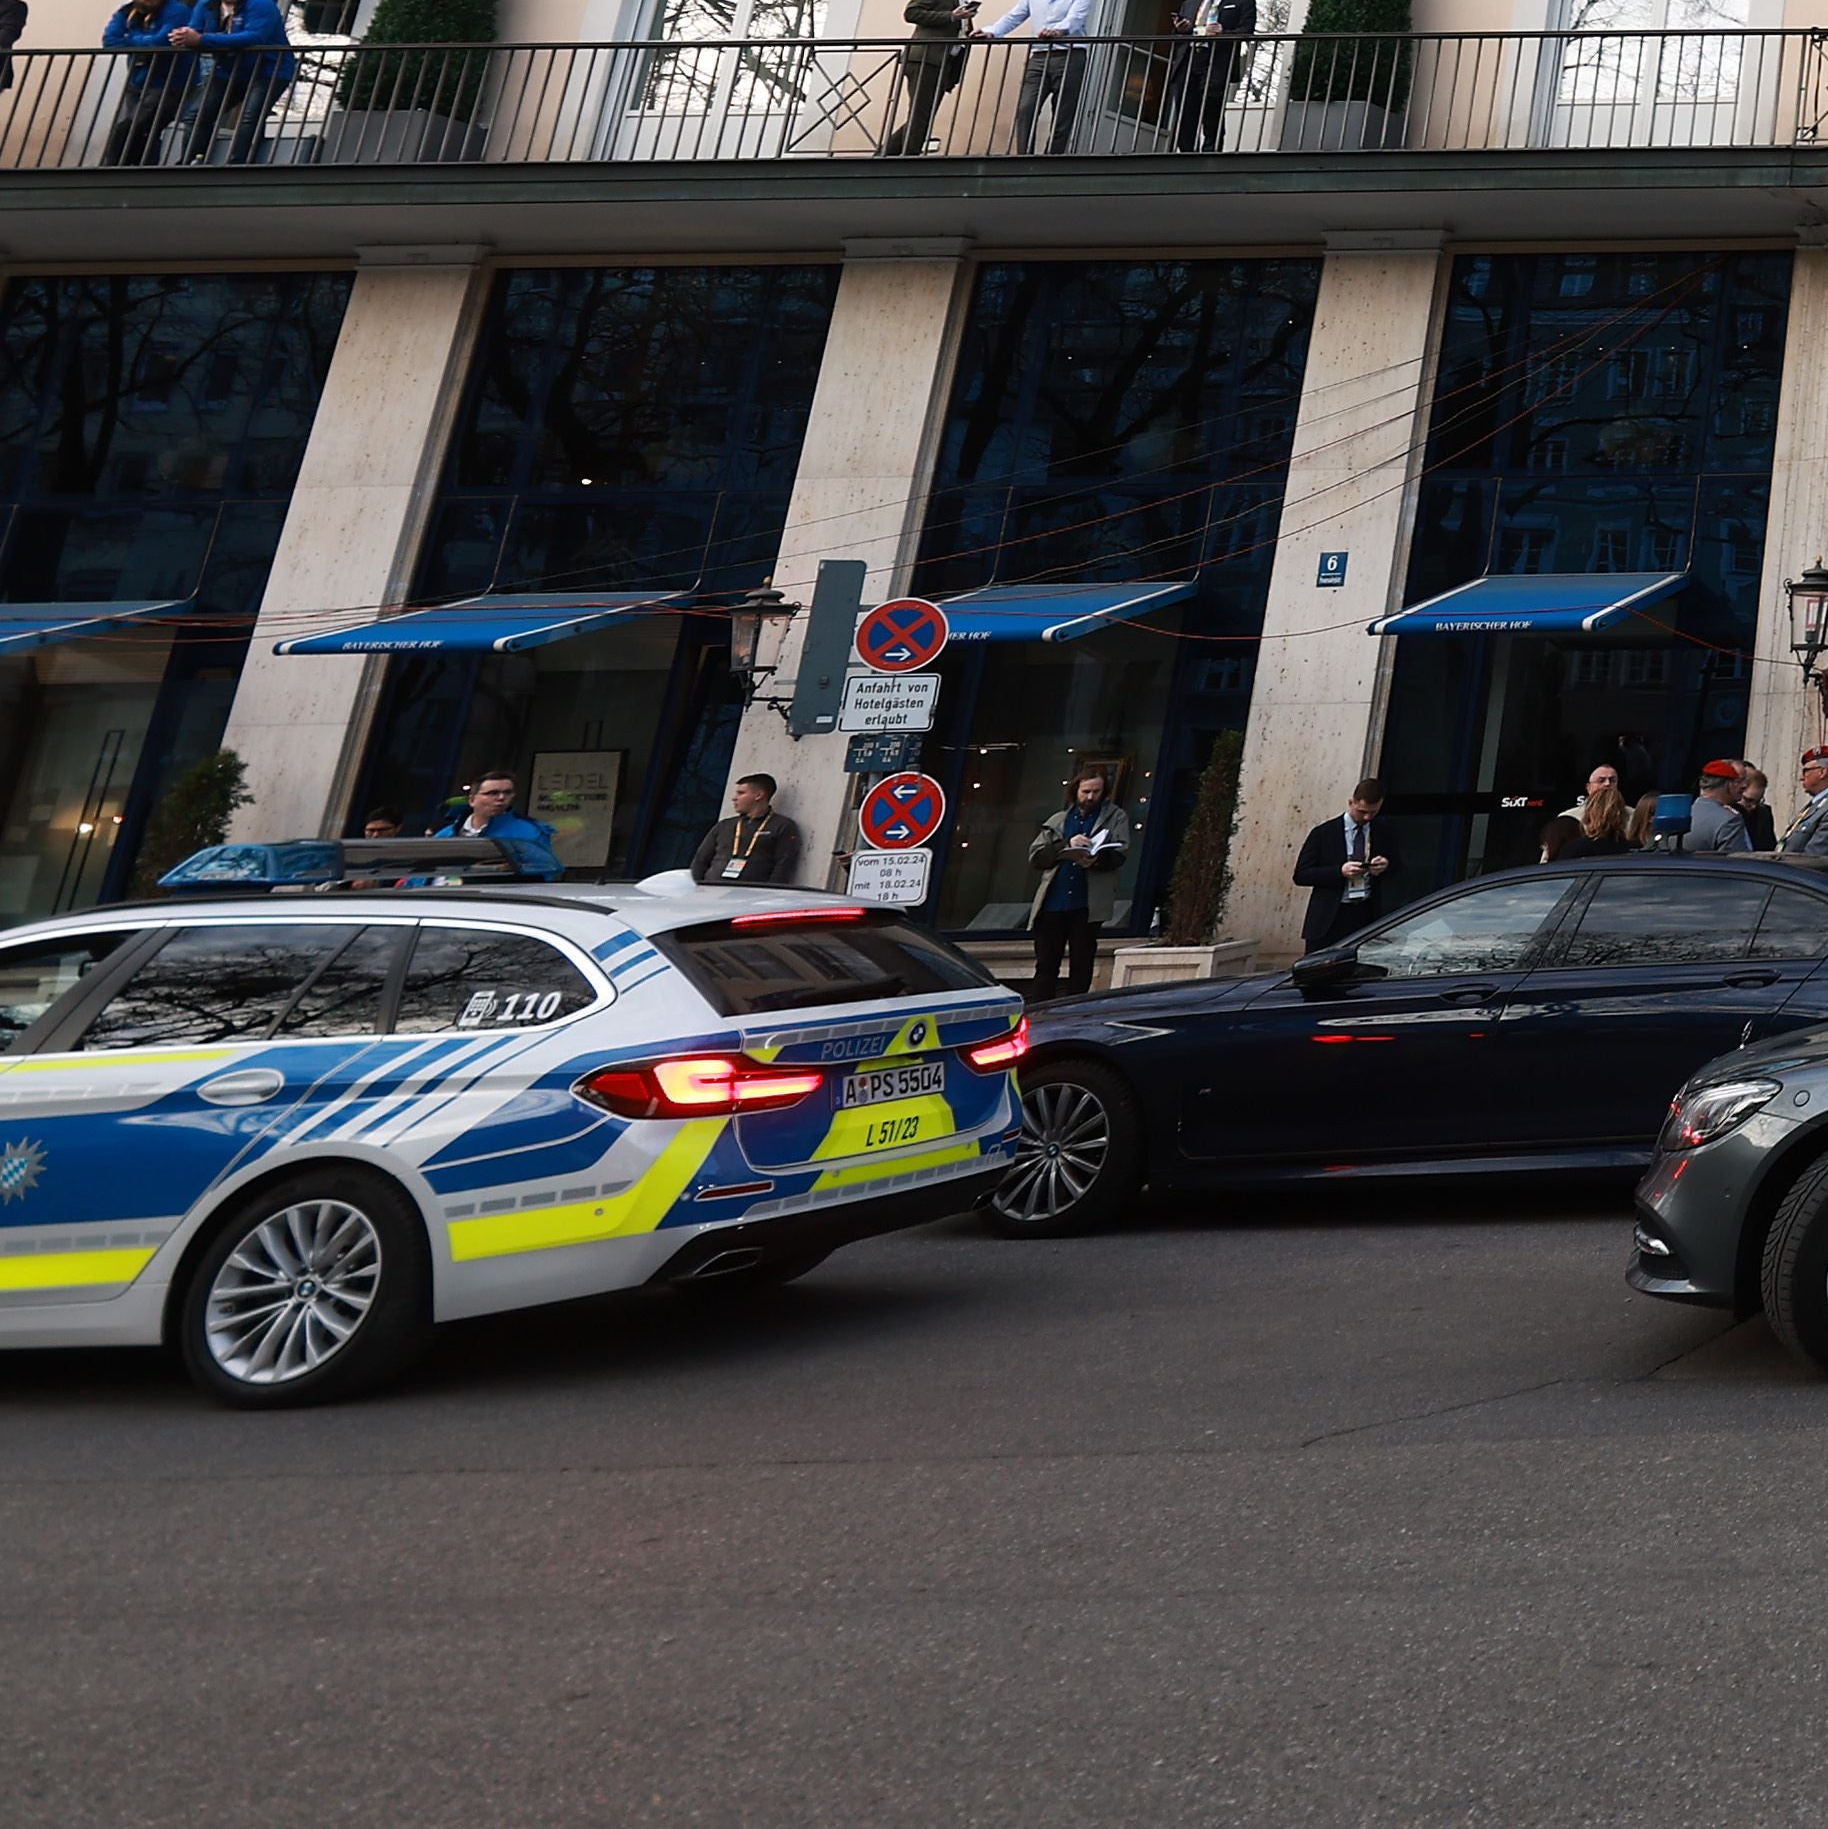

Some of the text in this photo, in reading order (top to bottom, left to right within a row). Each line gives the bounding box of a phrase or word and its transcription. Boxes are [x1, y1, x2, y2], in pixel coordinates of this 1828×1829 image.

[1327, 555, 1338, 571] 6
[1435, 619, 1533, 631] BAYERISCHER HOF
[856, 682, 929, 693] Anfahrt von
[854, 697, 924, 712] Hotelgästen
[864, 713, 908, 725] erlaubt
[857, 856, 924, 866] vom 15.02.24
[880, 868, 902, 877] 08 h
[854, 879, 921, 890] mit 18.02.24
[877, 892, 899, 901] 18 h
[496, 991, 562, 1021] 110
[821, 1035, 885, 1060] POLIZEI
[846, 1065, 942, 1104] A PS 5504
[866, 1115, 919, 1147] L 51/23
